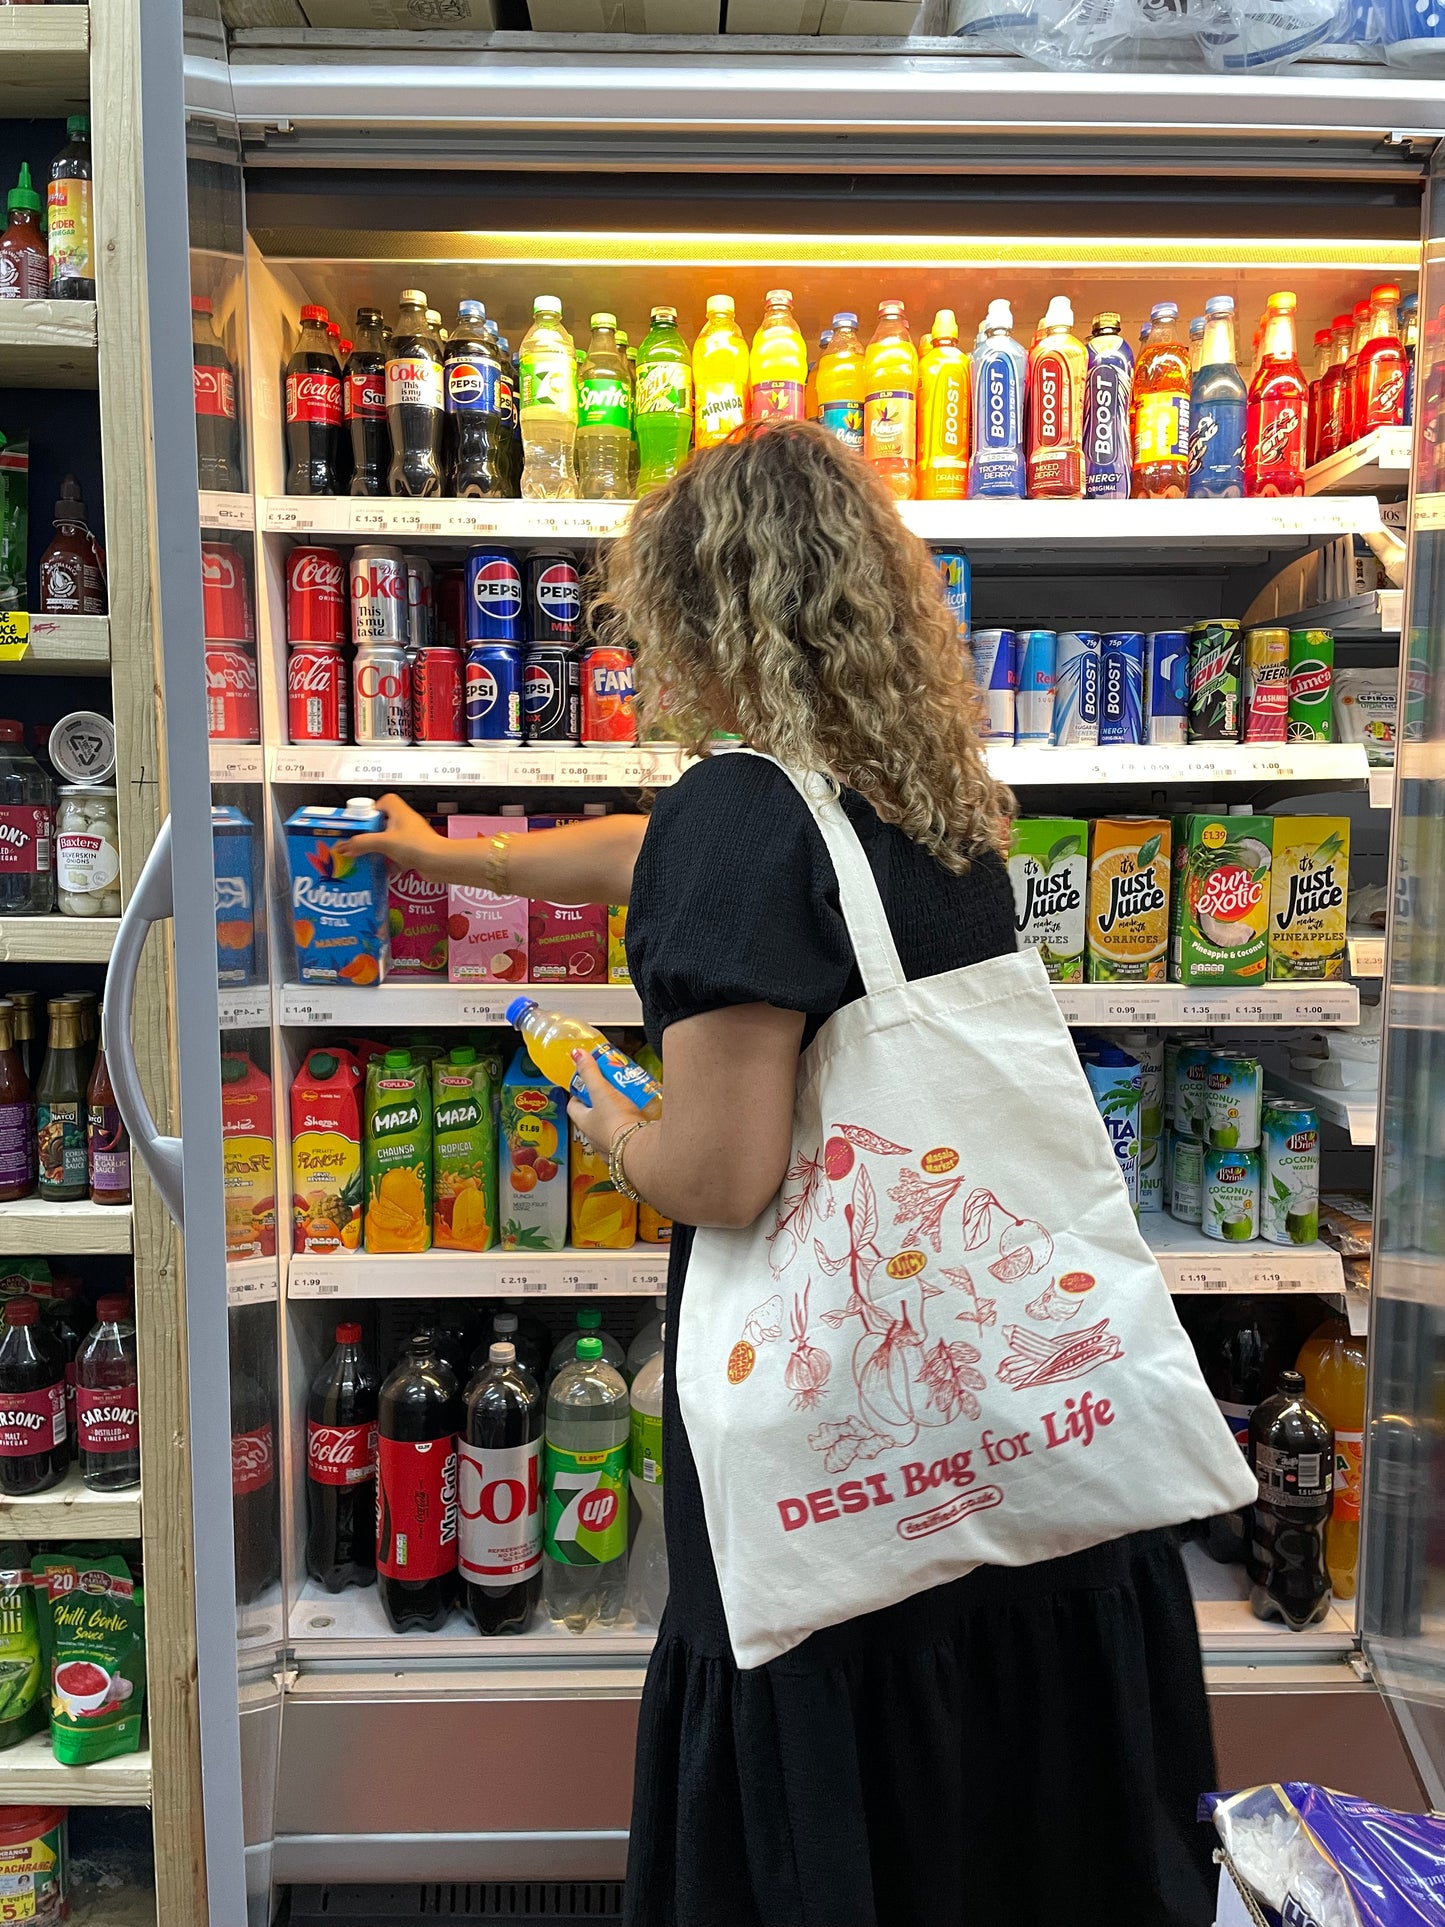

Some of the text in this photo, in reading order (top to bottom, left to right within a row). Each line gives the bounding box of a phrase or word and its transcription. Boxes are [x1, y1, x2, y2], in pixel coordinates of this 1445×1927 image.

[52, 220, 75, 229] CIDER
[402, 381, 420, 390] This
[451, 378, 482, 390] PEPSI
[401, 388, 421, 398] is my
[578, 386, 629, 411] Sprite
[990, 368, 1005, 439] BOOST
[1042, 367, 1057, 438] BOOST
[945, 376, 960, 447] BOOST
[1094, 375, 1113, 457] BOOST
[978, 464, 1018, 473] TROPICAL
[1035, 463, 1060, 472] MIXED
[983, 471, 1013, 481] BERRY
[1034, 471, 1061, 480] BERRY
[1087, 484, 1117, 494] ORIGINAL
[351, 566, 406, 600] oke
[477, 583, 521, 599] PEPSI
[540, 585, 579, 601] PEPS
[358, 606, 382, 617] This
[357, 617, 386, 630] is my
[357, 626, 385, 637] taste
[1086, 639, 1098, 648] 75p
[1108, 639, 1123, 648] 75p
[594, 666, 635, 692] FAN
[1288, 668, 1332, 696] Limca
[1084, 658, 1097, 716] BOOST
[1107, 659, 1121, 715] BOOST
[387, 717, 396, 726] is
[1203, 830, 1226, 841] £1.39
[60, 838, 99, 850] Baxters
[1207, 869, 1249, 894] Sun
[293, 875, 373, 911] Rubicon
[1195, 882, 1263, 916] exotic
[403, 923, 440, 938] GUAVA
[314, 936, 358, 949] MANGO
[467, 929, 510, 945] LYCHEE
[538, 930, 595, 946] POMEGRANATE
[1023, 935, 1069, 945] APPLES
[1103, 935, 1159, 945] ORANGES
[1272, 932, 1345, 942] PINEAPPLES
[1191, 940, 1266, 960] Pineapple & Coconut
[292, 1006, 313, 1014] 1.49
[471, 1006, 491, 1014] 1.99
[1116, 1006, 1136, 1014] 0.99
[1191, 1006, 1210, 1014] 1.35
[1243, 1006, 1263, 1014] 1.35
[1304, 1006, 1323, 1014] 1.00
[52, 1112, 75, 1122] NATCO
[374, 1107, 419, 1132] MAZA
[436, 1104, 478, 1128] MAZA
[377, 1143, 415, 1159] CHAUNSA
[437, 1141, 473, 1154] TROPICAL
[94, 1154, 115, 1162] CHILLI
[95, 1166, 116, 1174] SAUCE
[1208, 1186, 1254, 1196] COCONUT
[890, 1252, 926, 1278] JUICY
[81, 1406, 138, 1428] SARSON'S
[4, 1432, 21, 1440] MALT
[94, 1428, 122, 1436] DISTILLED
[103, 1434, 130, 1442] VINEGAR
[777, 1390, 1116, 1532] DESI Bag for Life
[314, 1463, 339, 1473] TASTE
[552, 1470, 615, 1543] 7 up
[53, 1574, 74, 1591] 20
[54, 1604, 128, 1632] Chilli Garlic
[72, 1626, 105, 1642] Sauce
[2, 1904, 18, 1920] 5
